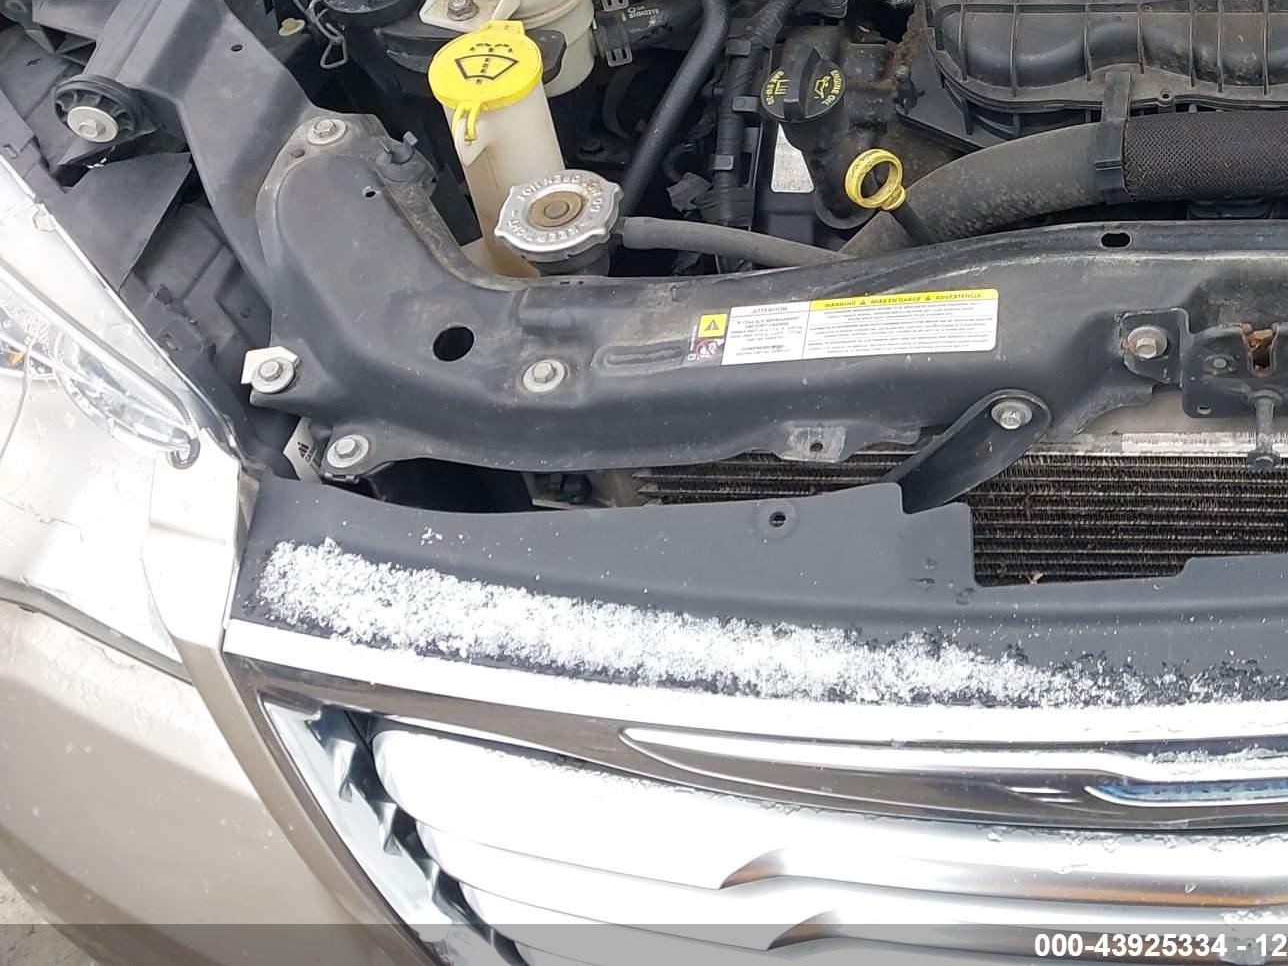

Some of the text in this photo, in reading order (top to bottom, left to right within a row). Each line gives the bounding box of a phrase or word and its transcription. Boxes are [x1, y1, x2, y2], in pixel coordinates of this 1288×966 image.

[765, 70, 785, 105] SAE 5W-20
[821, 70, 841, 106] ENGINE OIL
